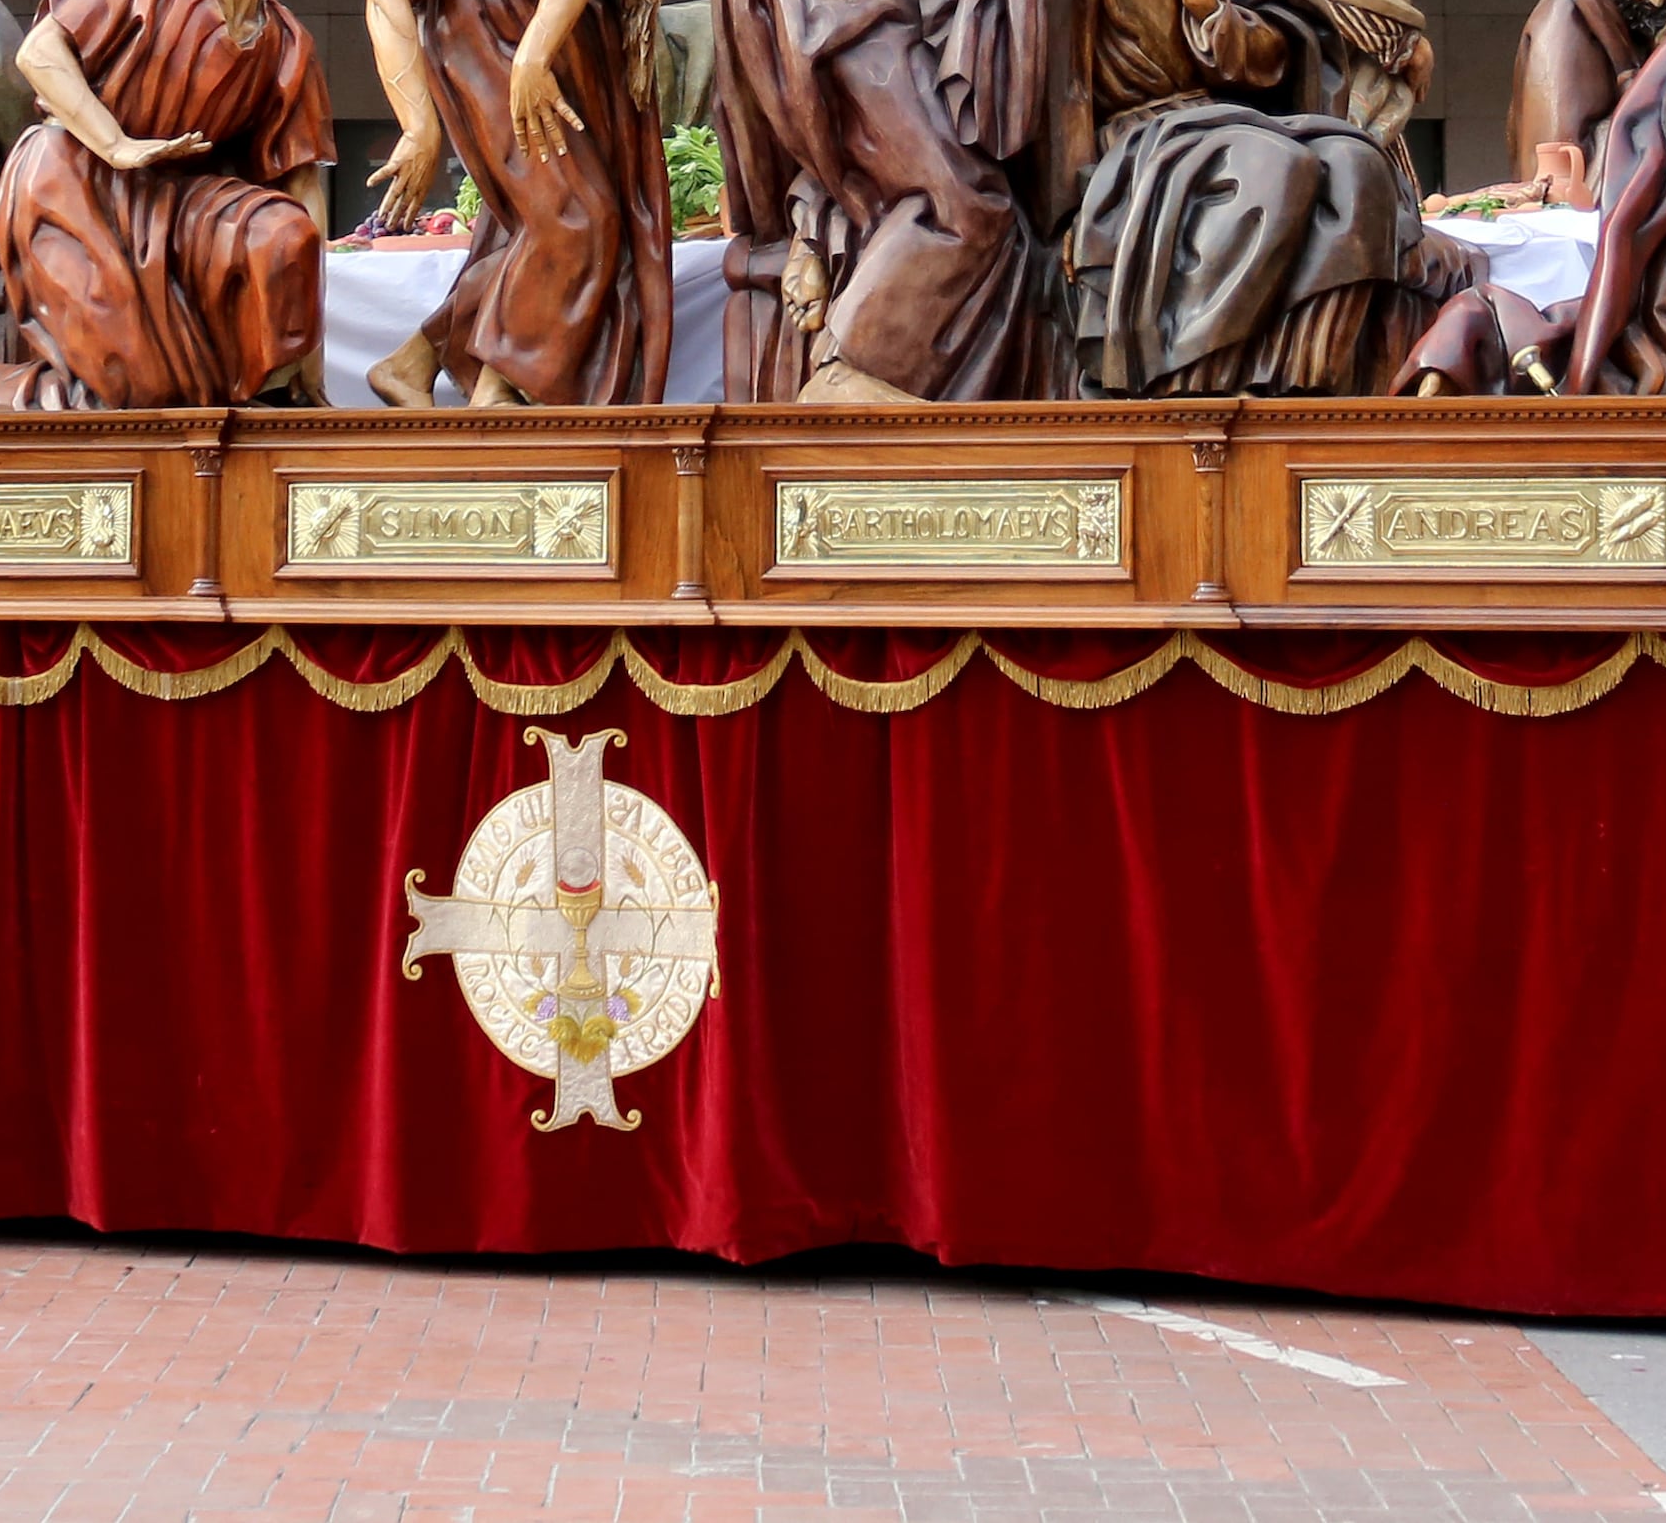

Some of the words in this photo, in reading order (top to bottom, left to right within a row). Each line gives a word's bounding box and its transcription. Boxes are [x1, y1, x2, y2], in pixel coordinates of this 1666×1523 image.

[380, 506, 520, 540] SIMON
[822, 505, 1070, 541] BARTHOLOMAEVS
[1384, 506, 1588, 543] ANDREAS
